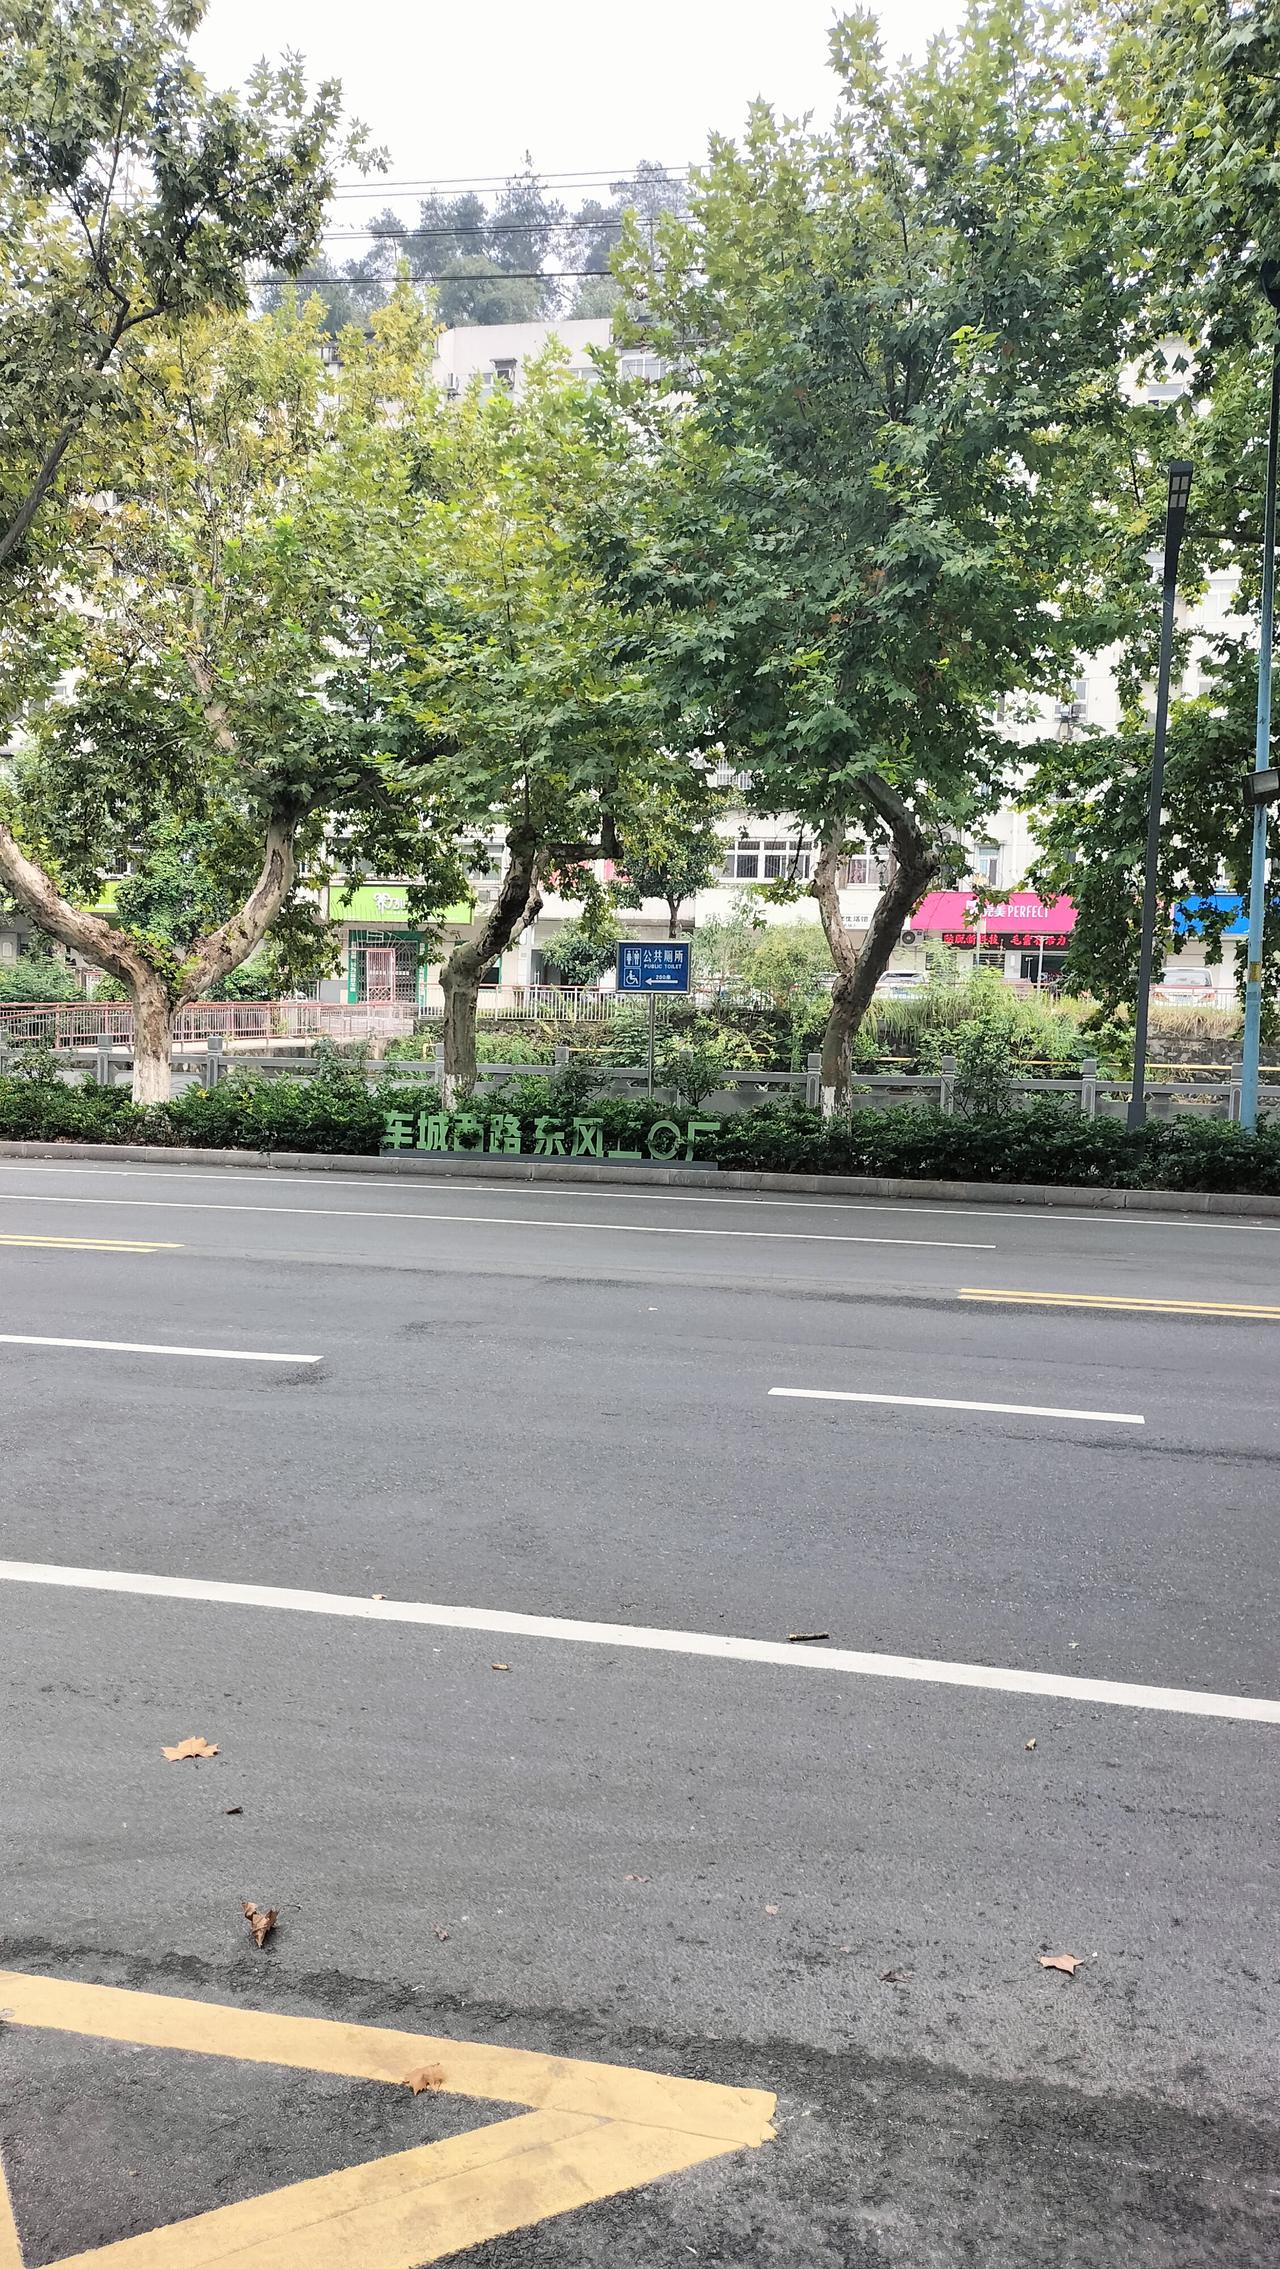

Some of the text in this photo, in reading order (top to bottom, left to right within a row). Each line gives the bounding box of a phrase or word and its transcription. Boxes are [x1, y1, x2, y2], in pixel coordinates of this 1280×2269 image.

[1008, 905, 1048, 918] PERFECT
[643, 949, 683, 963] 公共厕所
